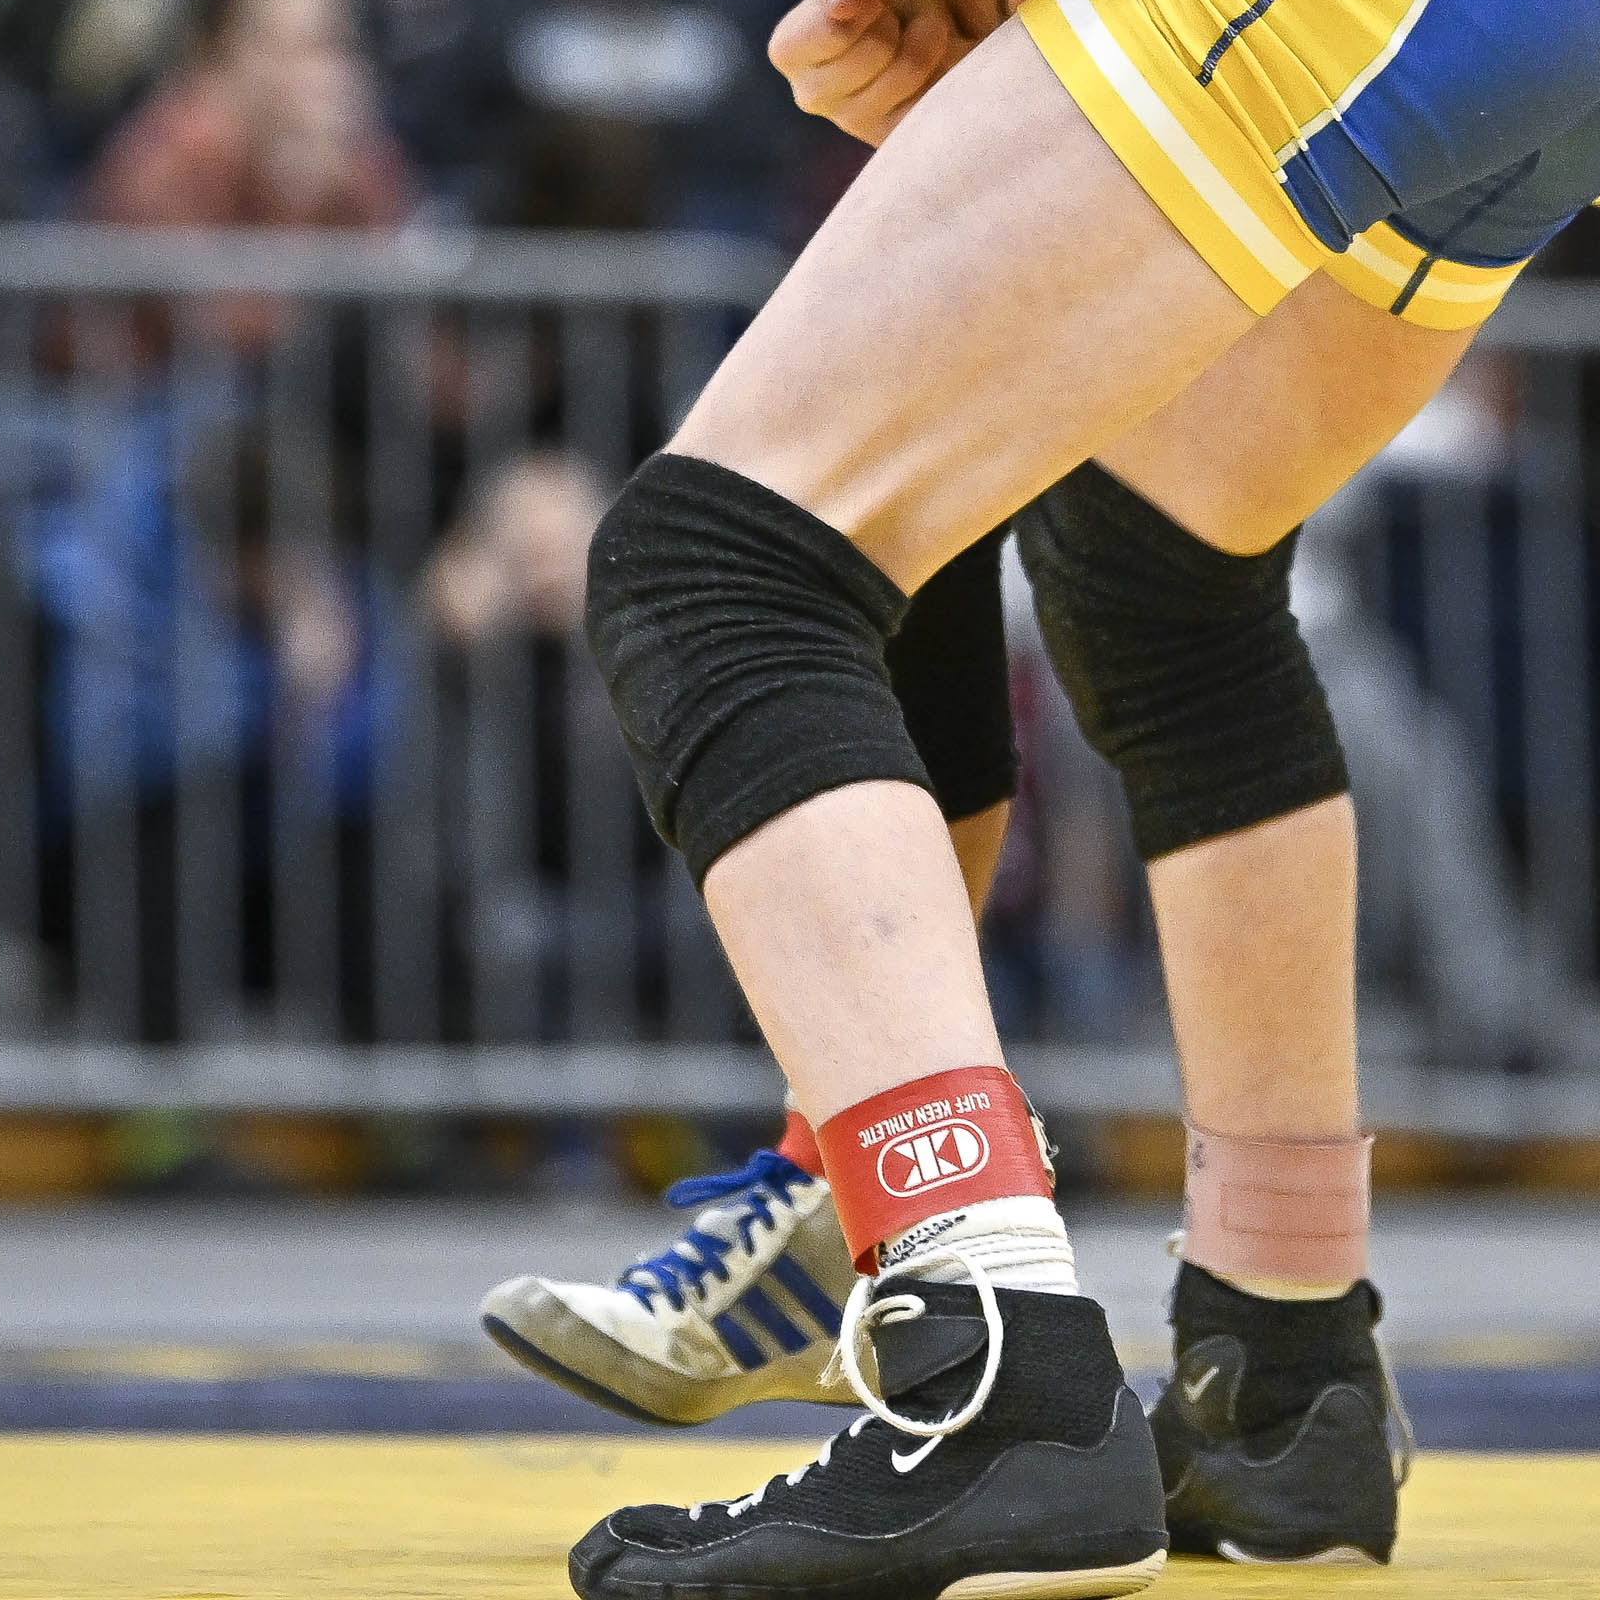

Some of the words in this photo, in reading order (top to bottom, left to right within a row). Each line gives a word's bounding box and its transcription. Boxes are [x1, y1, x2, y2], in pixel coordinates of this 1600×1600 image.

[915, 1099, 952, 1126] KEEN
[954, 1092, 991, 1114] CLIFF
[857, 1110, 915, 1149] ATHLETIC
